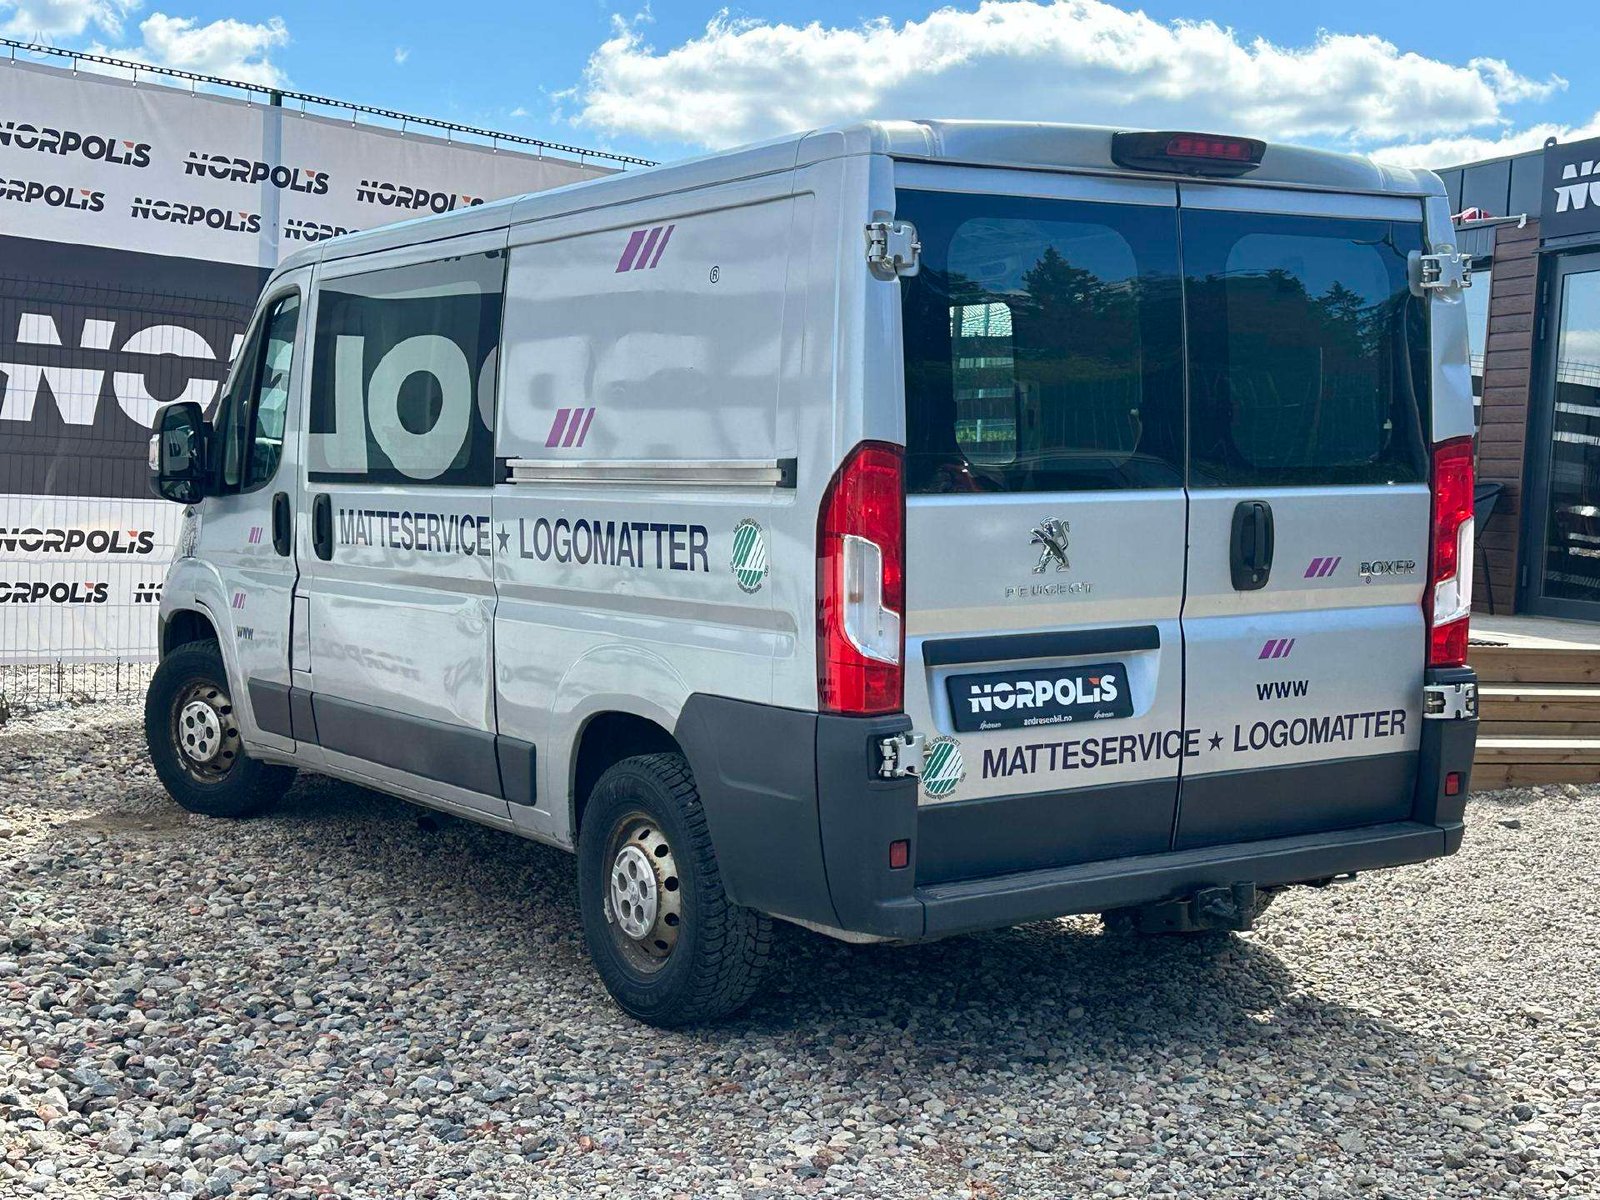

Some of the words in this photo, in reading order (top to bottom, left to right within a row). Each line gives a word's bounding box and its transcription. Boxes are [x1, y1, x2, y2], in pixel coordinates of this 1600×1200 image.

[339, 508, 492, 557] MATTESERVICE
[518, 516, 710, 572] LOGOMATTER
[1358, 559, 1416, 576] BOXER
[1004, 581, 1092, 598] PEUGEOT
[1256, 679, 1309, 702] WWW
[982, 728, 1201, 780] MATTESERVICE
[1233, 709, 1407, 754] LOGOMATTER
